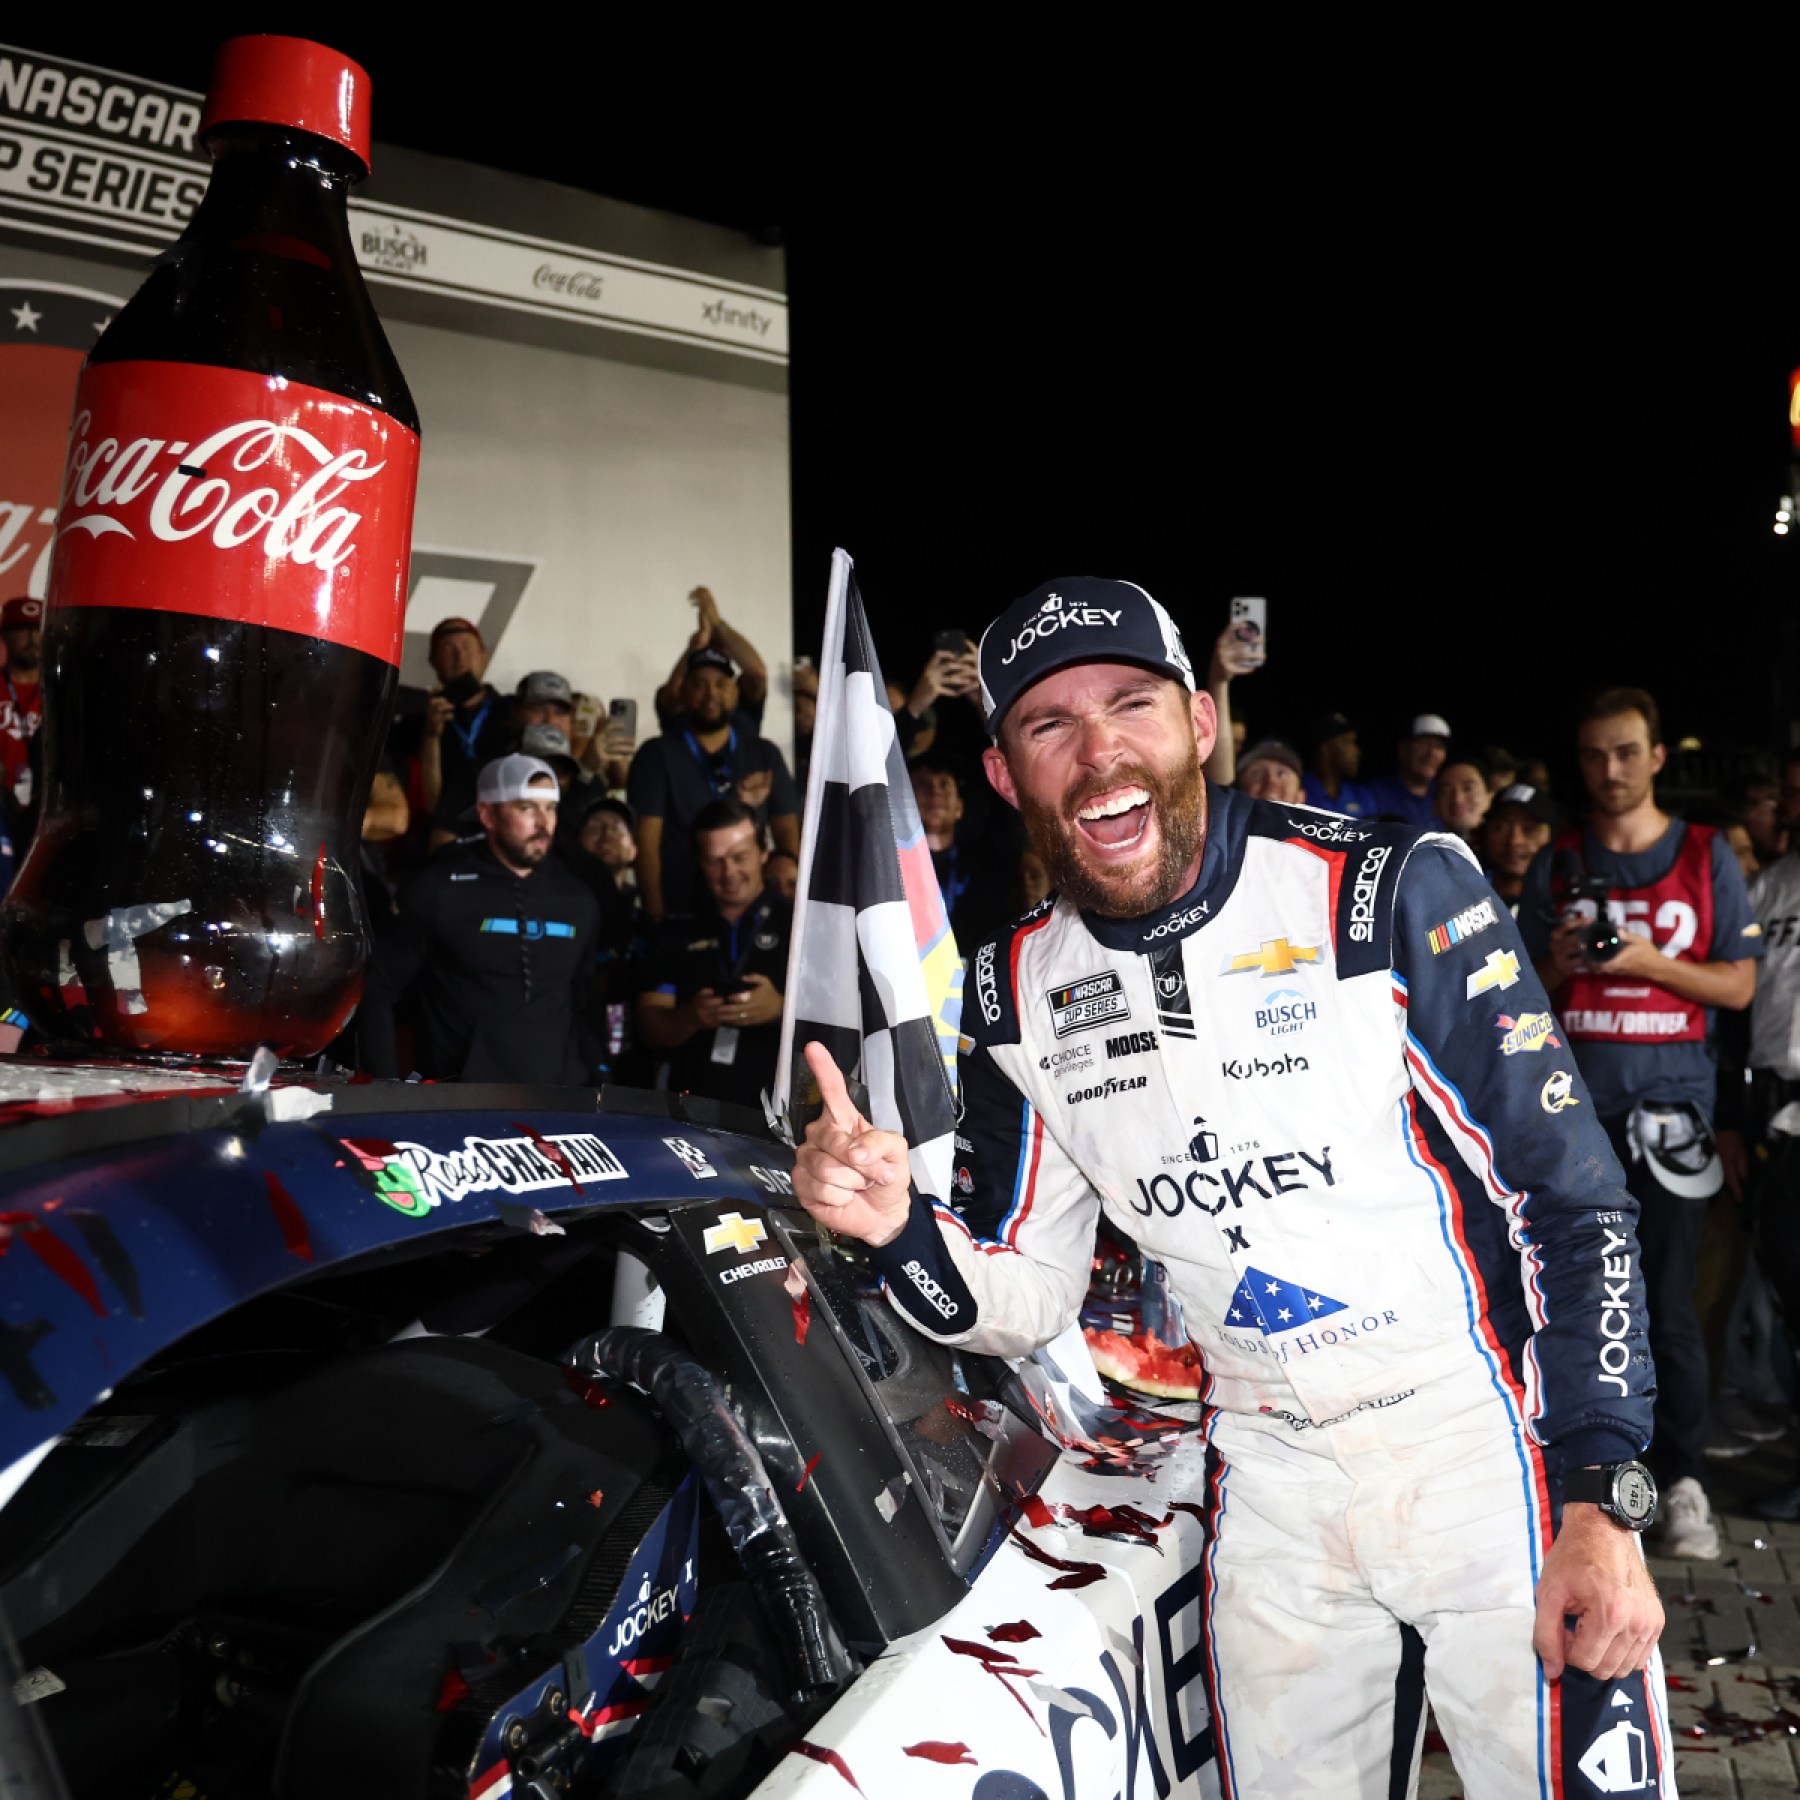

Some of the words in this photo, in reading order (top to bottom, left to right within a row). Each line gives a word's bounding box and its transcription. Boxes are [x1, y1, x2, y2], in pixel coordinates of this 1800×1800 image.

[0, 57, 202, 152] NASCAR
[27, 147, 206, 222] SERIES
[362, 231, 427, 266] BUSCH
[701, 299, 772, 337] xfinity
[1001, 608, 1123, 665] JOCKEY
[1287, 819, 1373, 842] JOCKEY
[1348, 846, 1392, 943] sparco
[1142, 900, 1211, 941] JOCKEY
[1766, 916, 1800, 947] FF
[975, 942, 1001, 1026] sparco
[1074, 977, 1114, 1000] NASCAR
[1065, 1006, 1082, 1024] CUP
[1084, 997, 1117, 1018] SERIES
[1255, 1001, 1317, 1029] BUSCH
[1105, 1030, 1159, 1060] MOOSE
[1271, 1021, 1305, 1036] LIGHT
[1505, 1013, 1554, 1051] SUNOCO
[1051, 1043, 1092, 1066] CHOICE
[1222, 1052, 1310, 1080] Kubota
[1067, 1076, 1148, 1105] GOODYEAR
[1161, 1152, 1193, 1165] SINCE
[1230, 1139, 1261, 1155] 1876
[1129, 1145, 1336, 1218] JOCKEY
[719, 1256, 788, 1285] CHEVROLET
[901, 1260, 959, 1320] sparco
[1598, 1228, 1631, 1397] JOCKEY
[1295, 1310, 1399, 1354] HONOR
[1630, 1483, 1639, 1509] 146
[608, 1584, 679, 1657] JOCKEY
